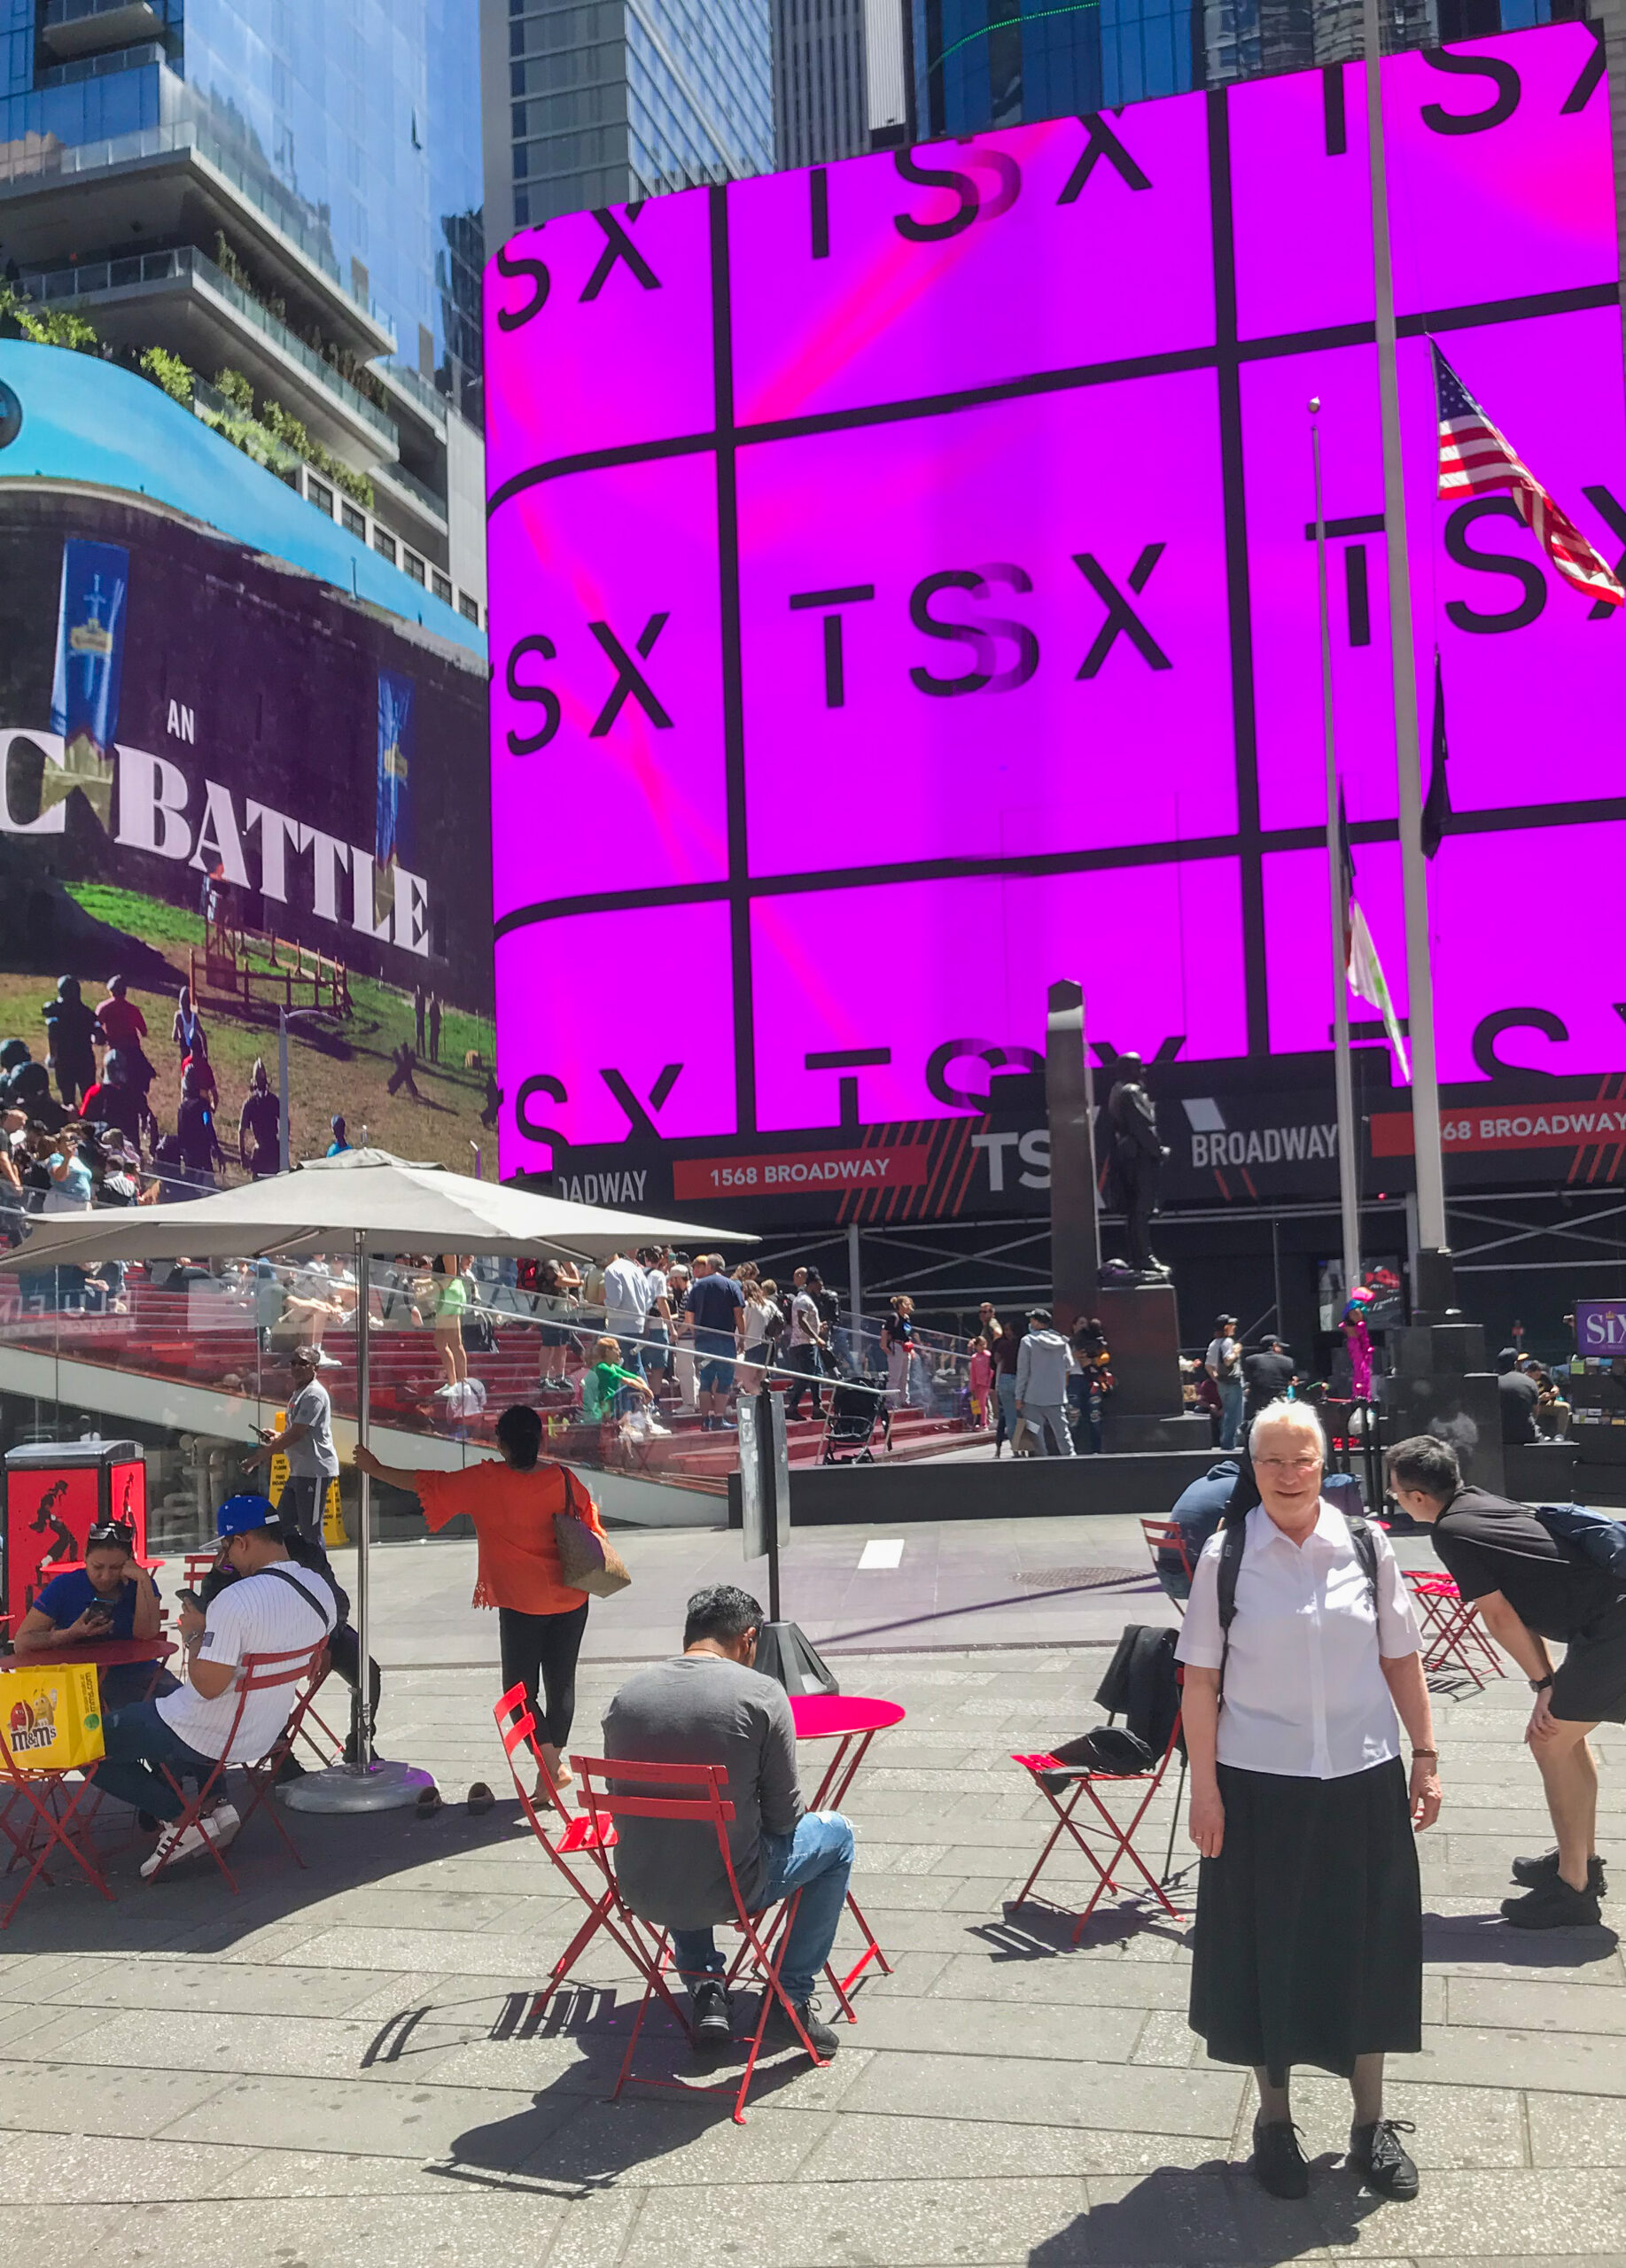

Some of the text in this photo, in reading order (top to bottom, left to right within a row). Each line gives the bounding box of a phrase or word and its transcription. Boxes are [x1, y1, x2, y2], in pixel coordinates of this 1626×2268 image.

[790, 542, 1173, 709] TSX
[488, 611, 674, 757] SX
[167, 698, 196, 745] AN
[113, 742, 430, 958] BATTLE
[1191, 1123, 1338, 1168] BROADWAY
[1439, 1112, 1626, 1141] 68 BROADWAY
[710, 1159, 891, 1187] 1568 BROADWAY
